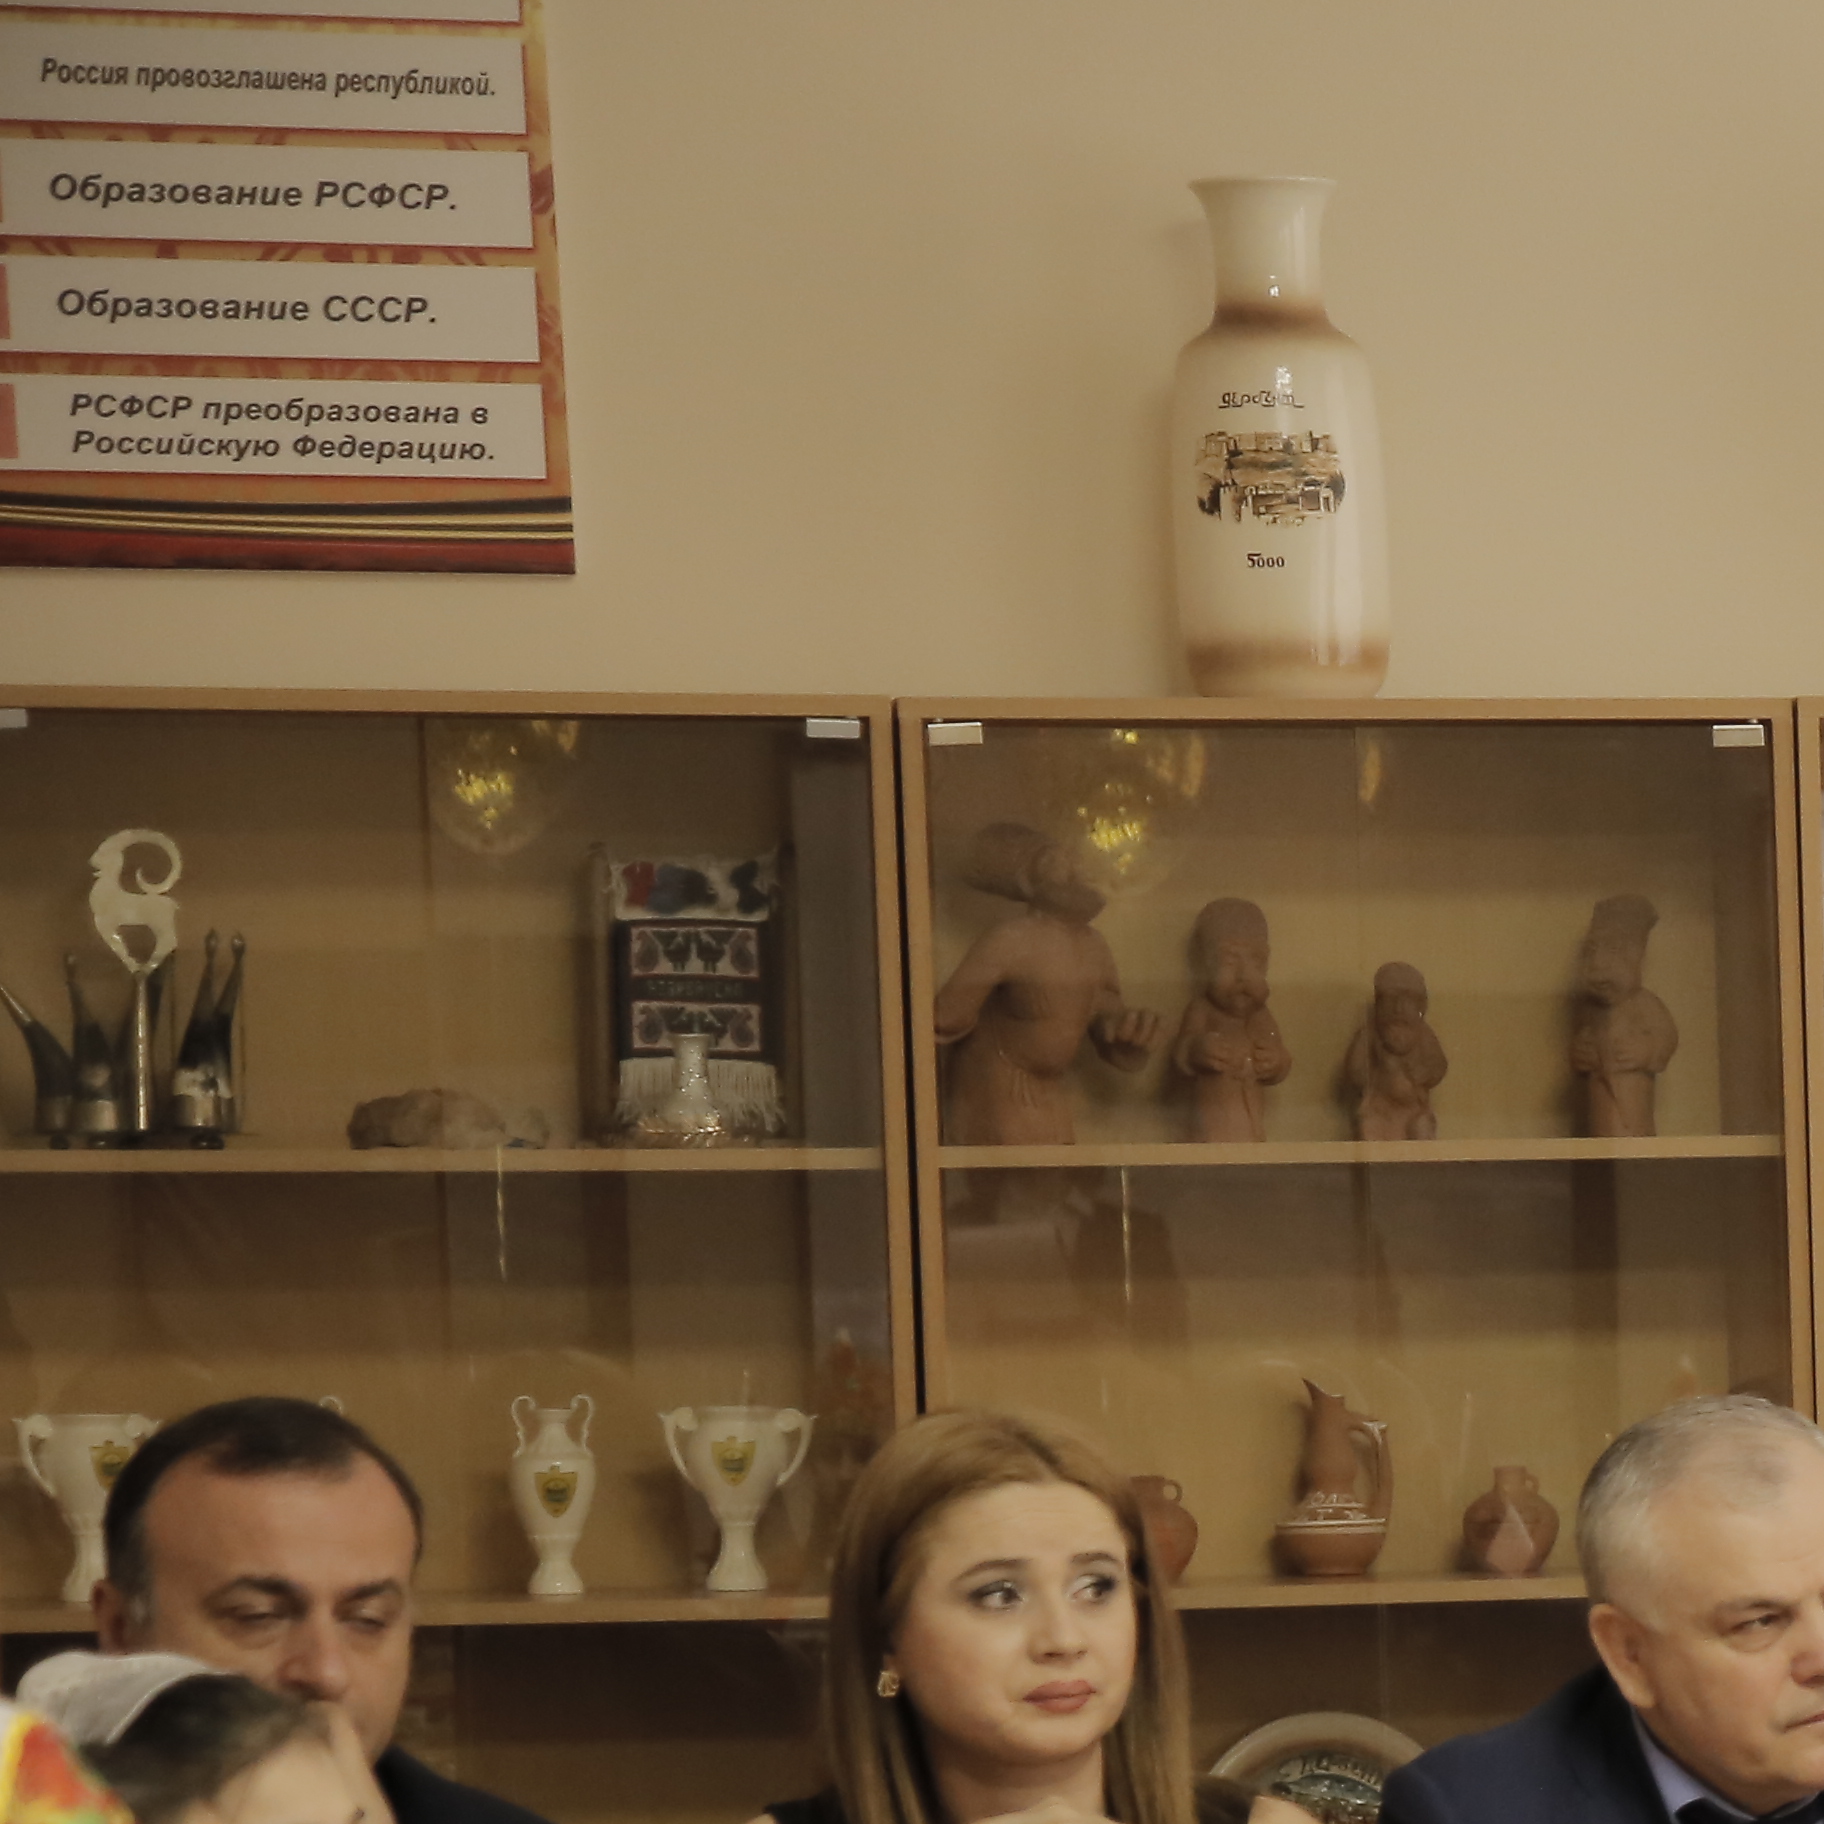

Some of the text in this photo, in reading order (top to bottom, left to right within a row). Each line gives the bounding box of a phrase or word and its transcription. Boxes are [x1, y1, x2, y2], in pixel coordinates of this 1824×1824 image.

[40, 57, 496, 100] Россия провозглашена республикой.
[48, 173, 456, 210] Образование РСФСР.
[56, 288, 436, 324] Образование СССР.
[69, 393, 488, 428] РСФСР преобразована в
[71, 430, 494, 465] Российскую Федерацию.
[1246, 552, 1286, 568] 5000
